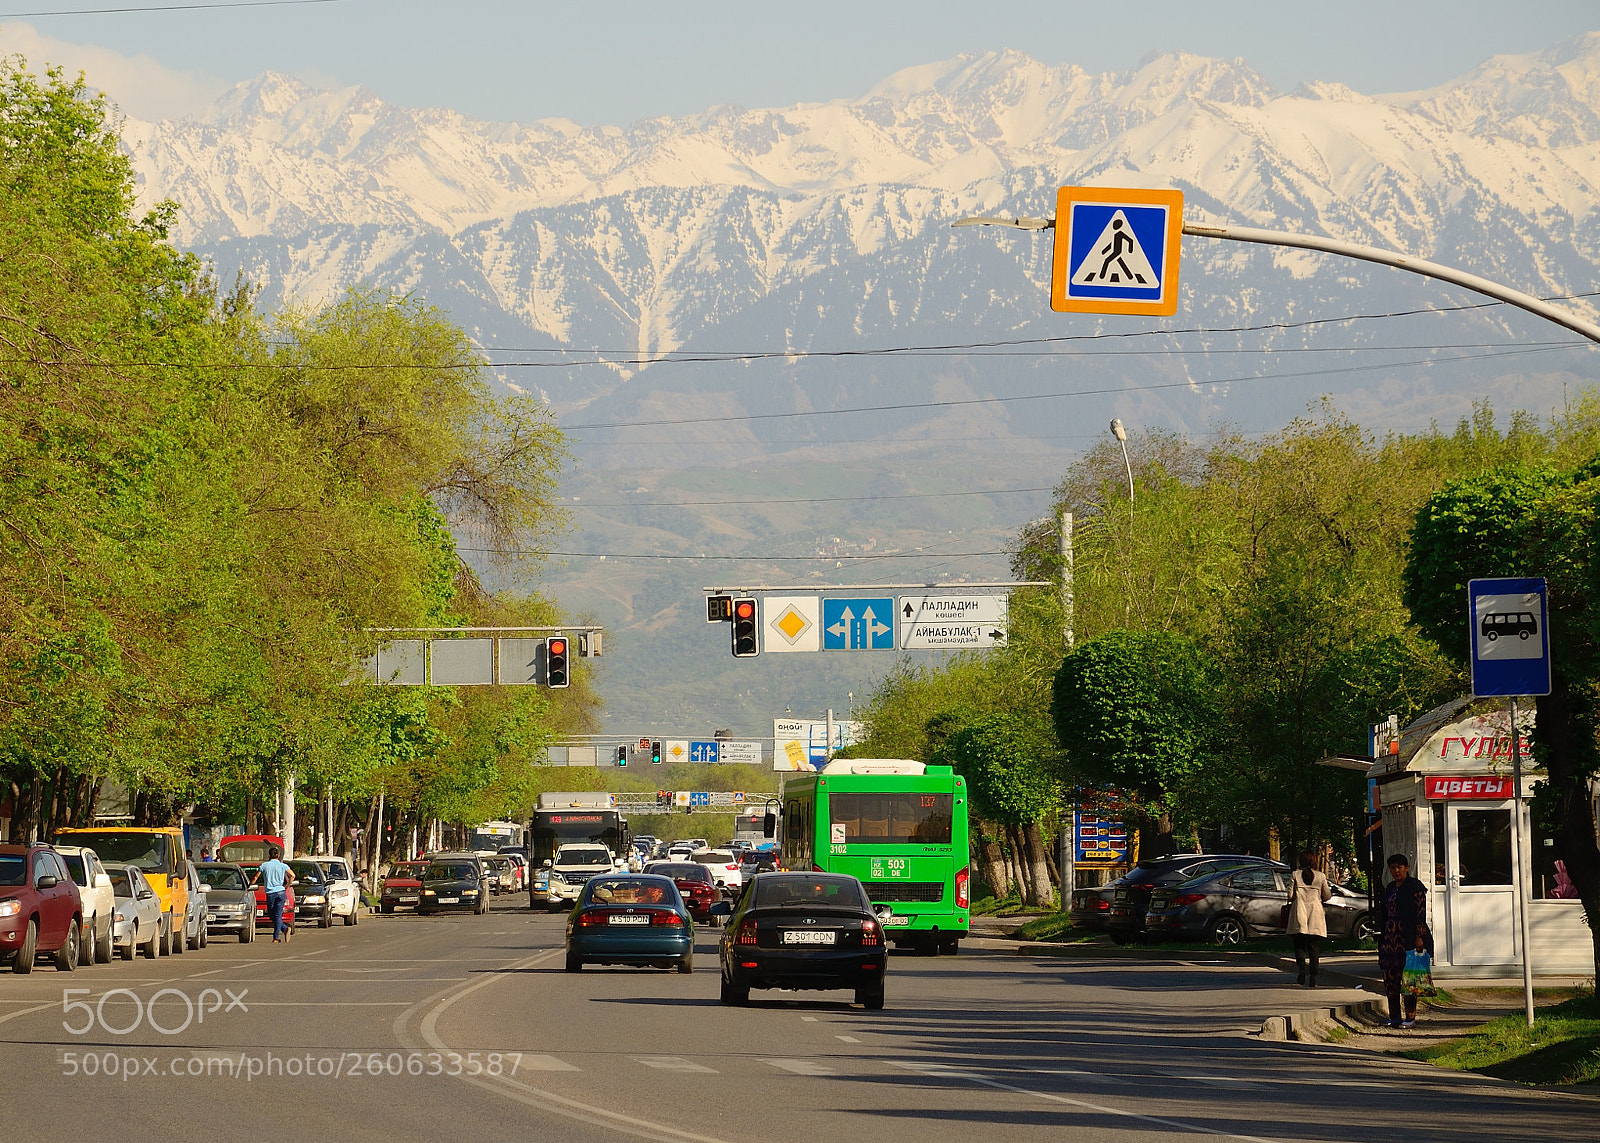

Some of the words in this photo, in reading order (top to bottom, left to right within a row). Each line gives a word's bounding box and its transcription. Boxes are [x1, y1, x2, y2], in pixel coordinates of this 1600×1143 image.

[921, 601, 979, 611] ПАЛЛАДИН
[640, 740, 650, 748] 26
[1434, 781, 1503, 796] ЦВЕТЫ
[920, 796, 936, 807] 137
[830, 845, 847, 854] 3102
[887, 860, 905, 869] 503
[786, 932, 793, 940] Z
[795, 932, 811, 941] 501
[813, 932, 833, 941] CDN
